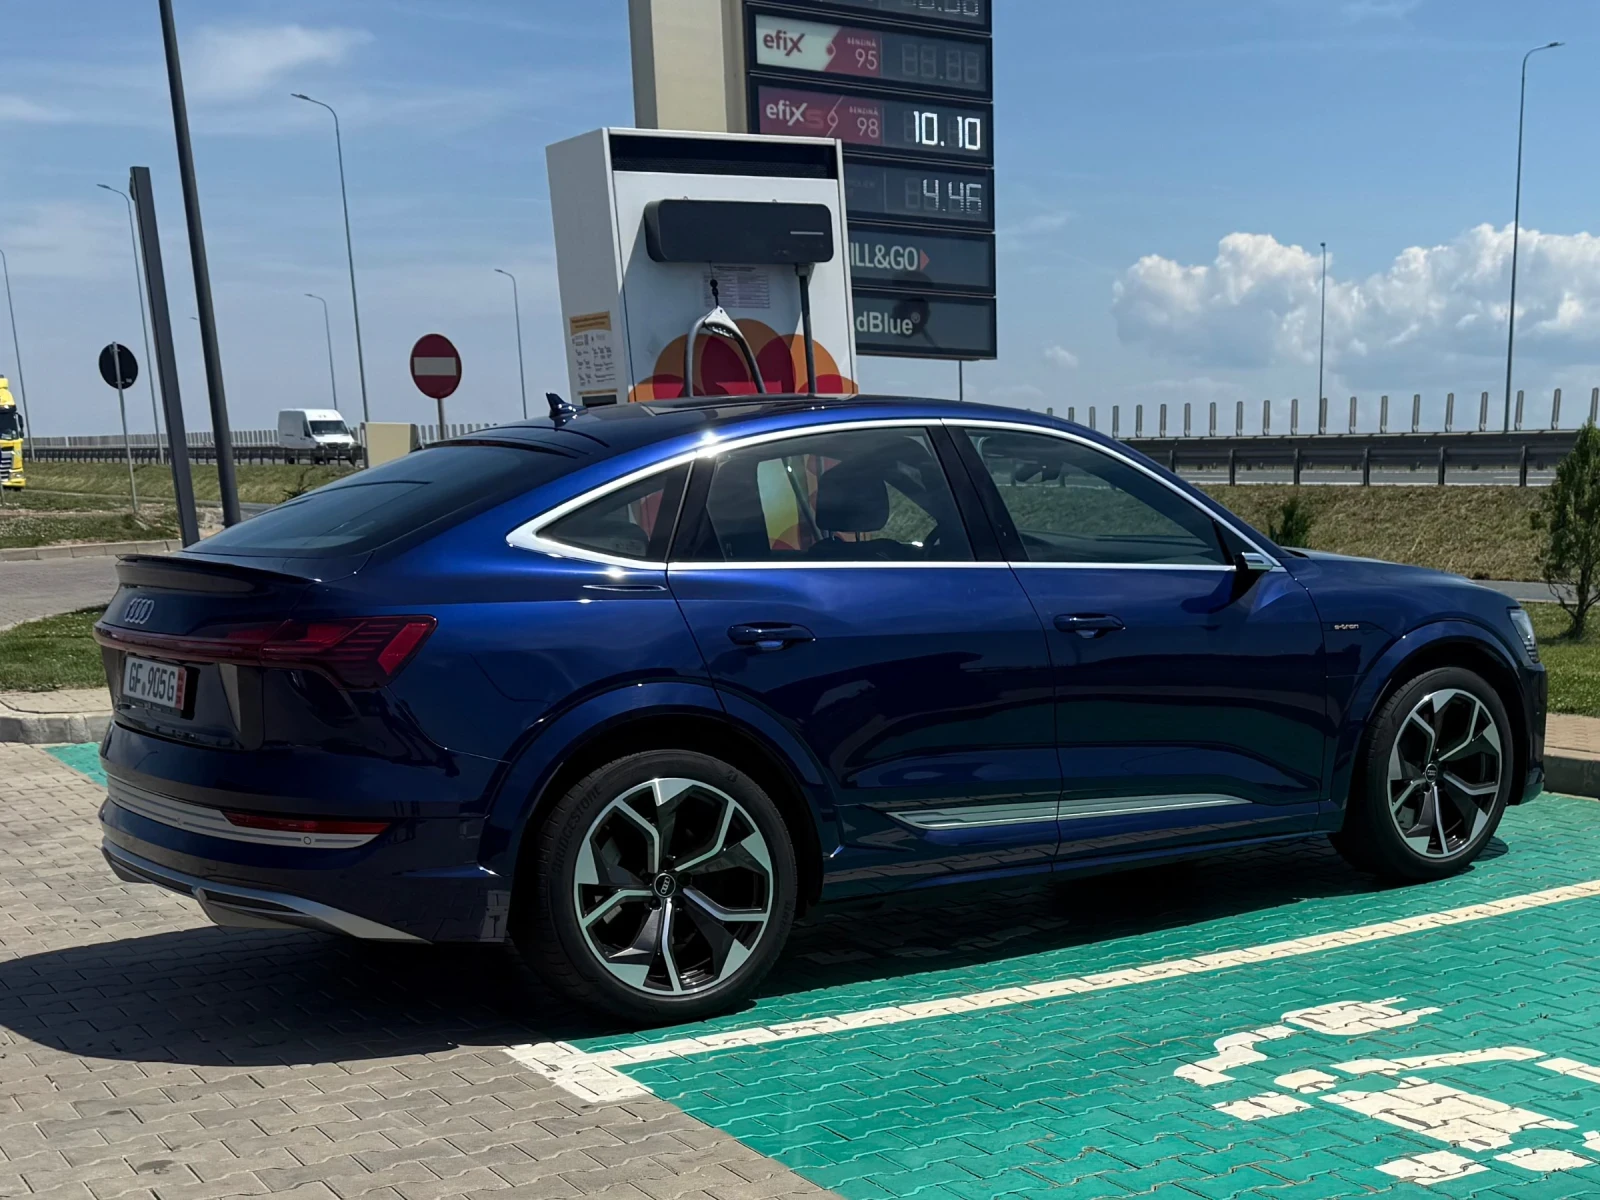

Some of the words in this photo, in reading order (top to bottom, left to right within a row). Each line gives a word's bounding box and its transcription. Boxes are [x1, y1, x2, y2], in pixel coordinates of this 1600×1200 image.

[763, 30, 805, 56] efix
[855, 48, 878, 70] 95
[857, 117, 880, 138] 98
[913, 110, 981, 151] 10.10
[922, 179, 982, 214] 4.46
[850, 242, 919, 271] ILL&GO
[129, 662, 143, 694] GF
[147, 666, 176, 702] 905G
